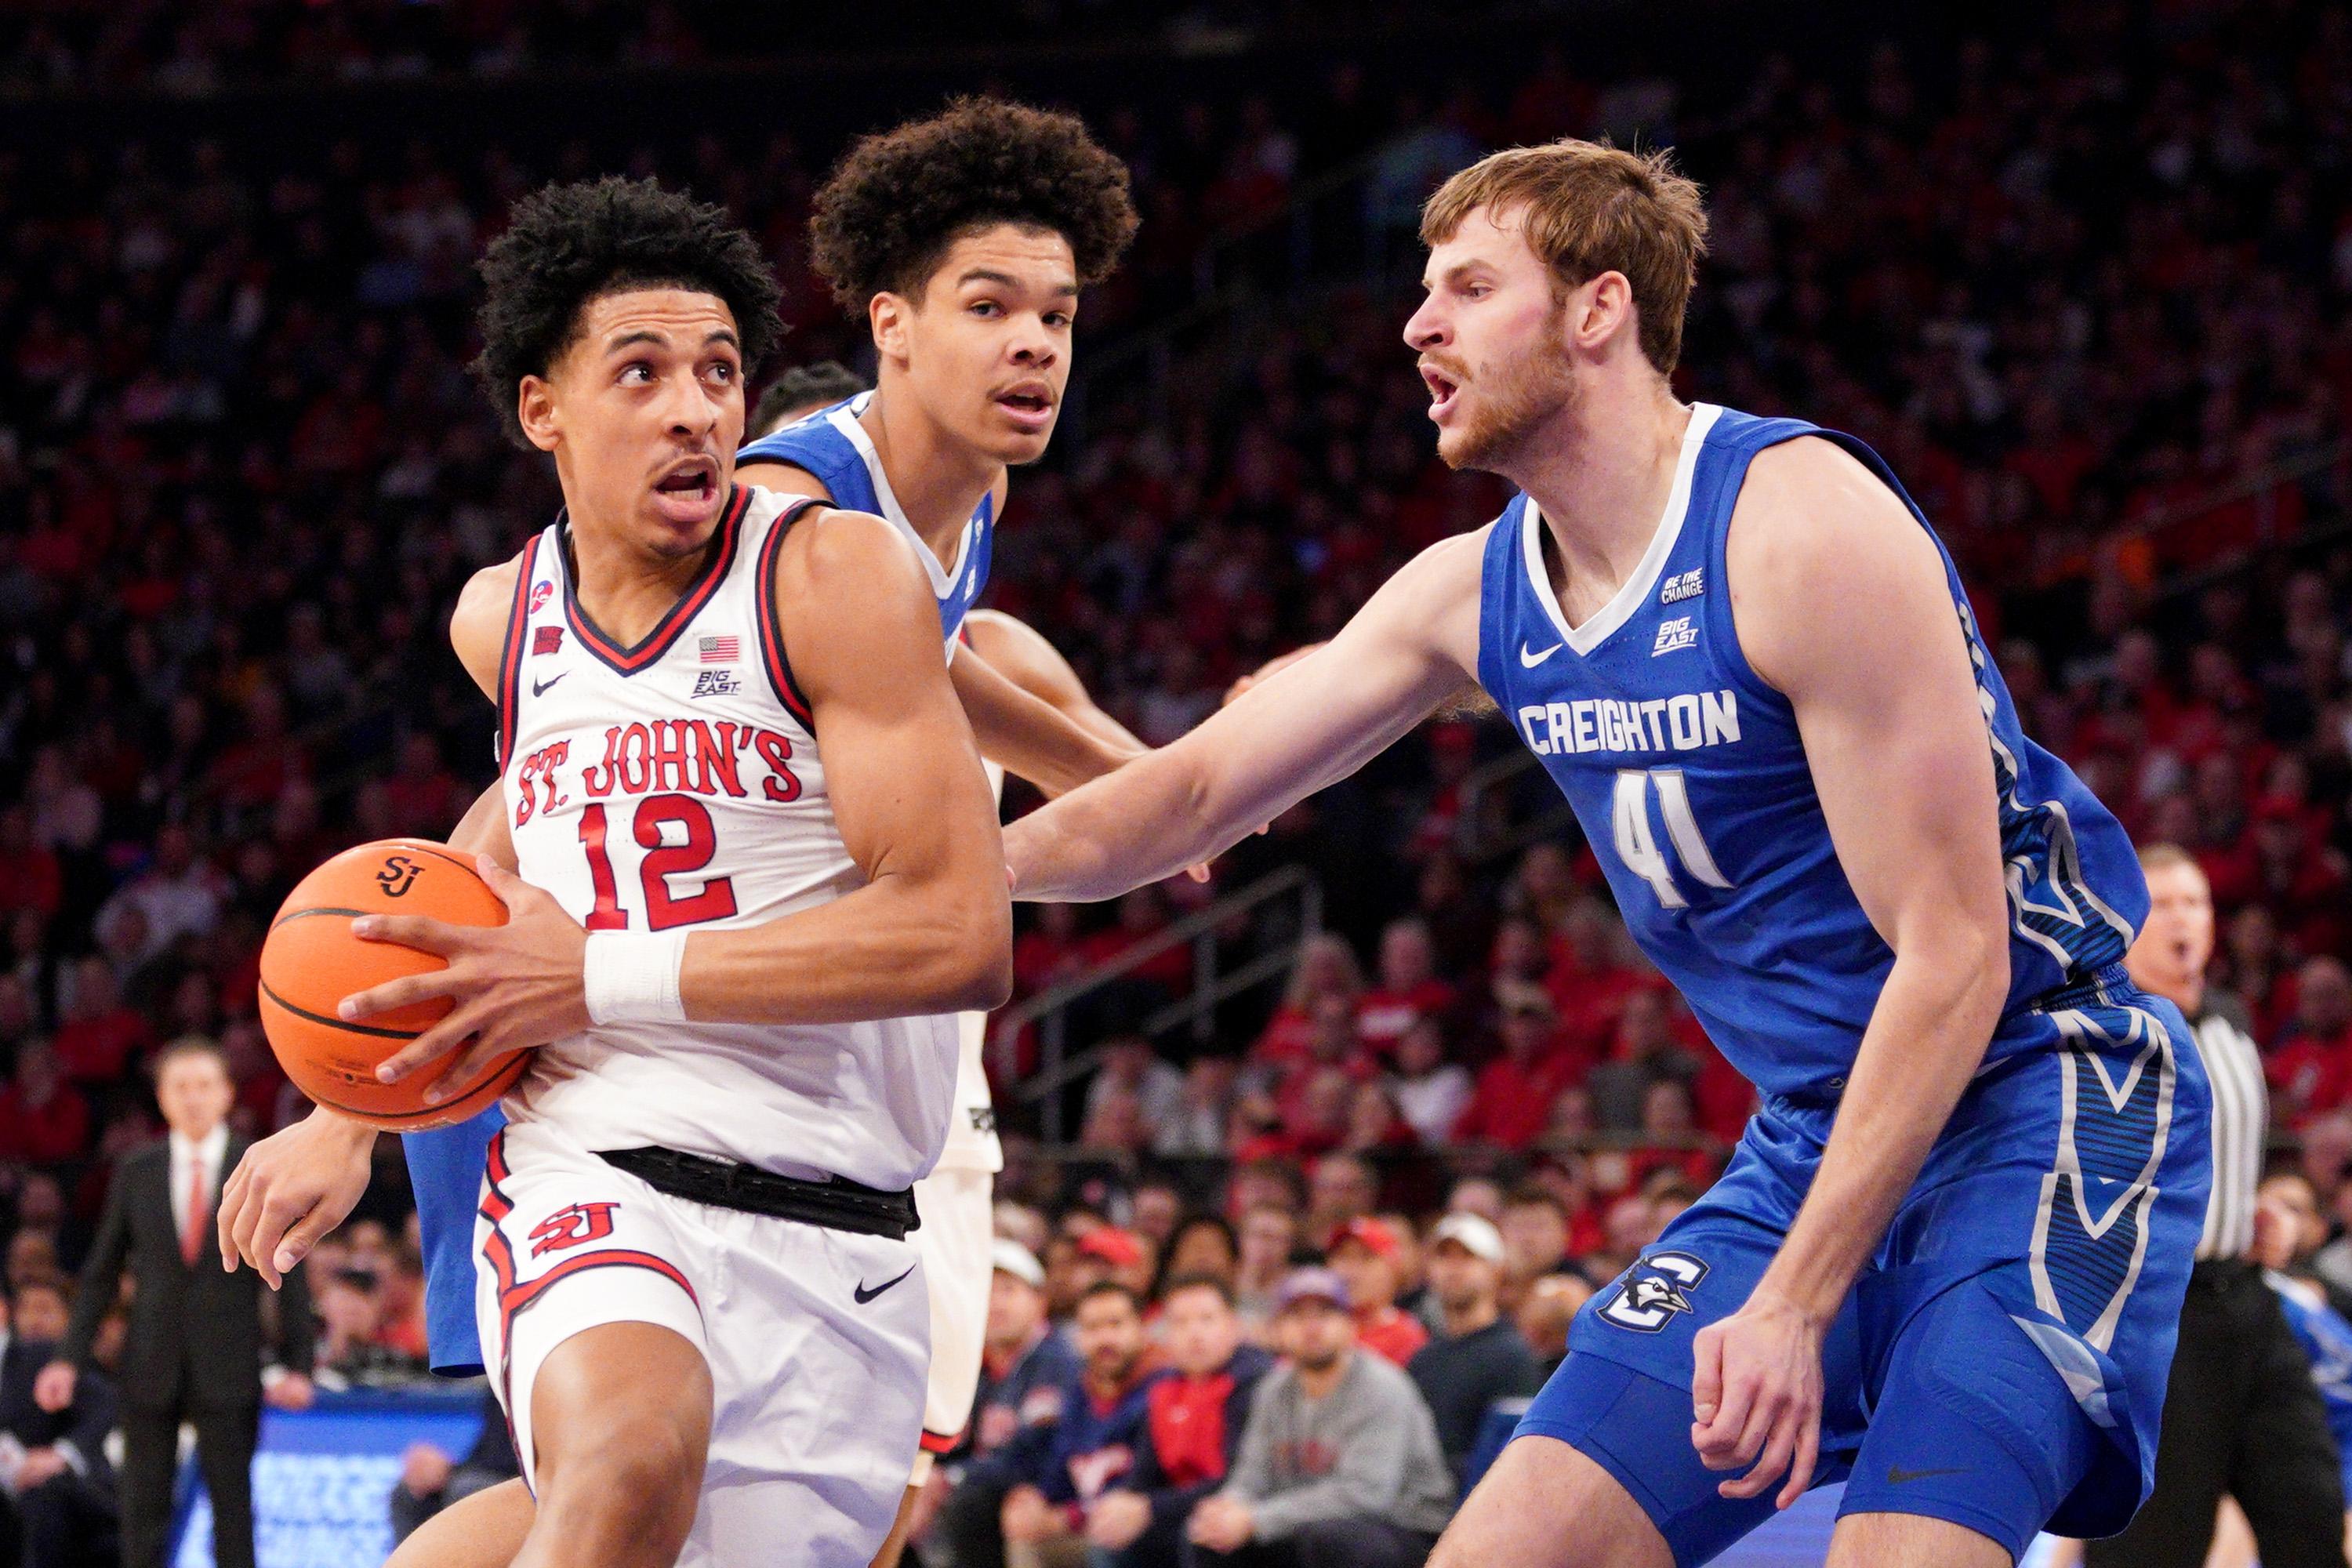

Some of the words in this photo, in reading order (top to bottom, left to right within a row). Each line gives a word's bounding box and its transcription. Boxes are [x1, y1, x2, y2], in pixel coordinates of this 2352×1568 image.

[1664, 575, 1682, 590] BE
[1682, 567, 1703, 585] THE
[1661, 580, 1704, 604] CHANGE
[1658, 616, 1690, 637] BIG
[1653, 629, 1698, 650] EAST
[693, 681, 741, 694] EAST
[699, 670, 731, 683] BIG
[1519, 690, 1741, 755] CREIGHTON
[515, 739, 571, 830] ST.
[583, 719, 802, 803] JOHN'S
[1612, 768, 1737, 909] 41
[579, 793, 738, 931] 12
